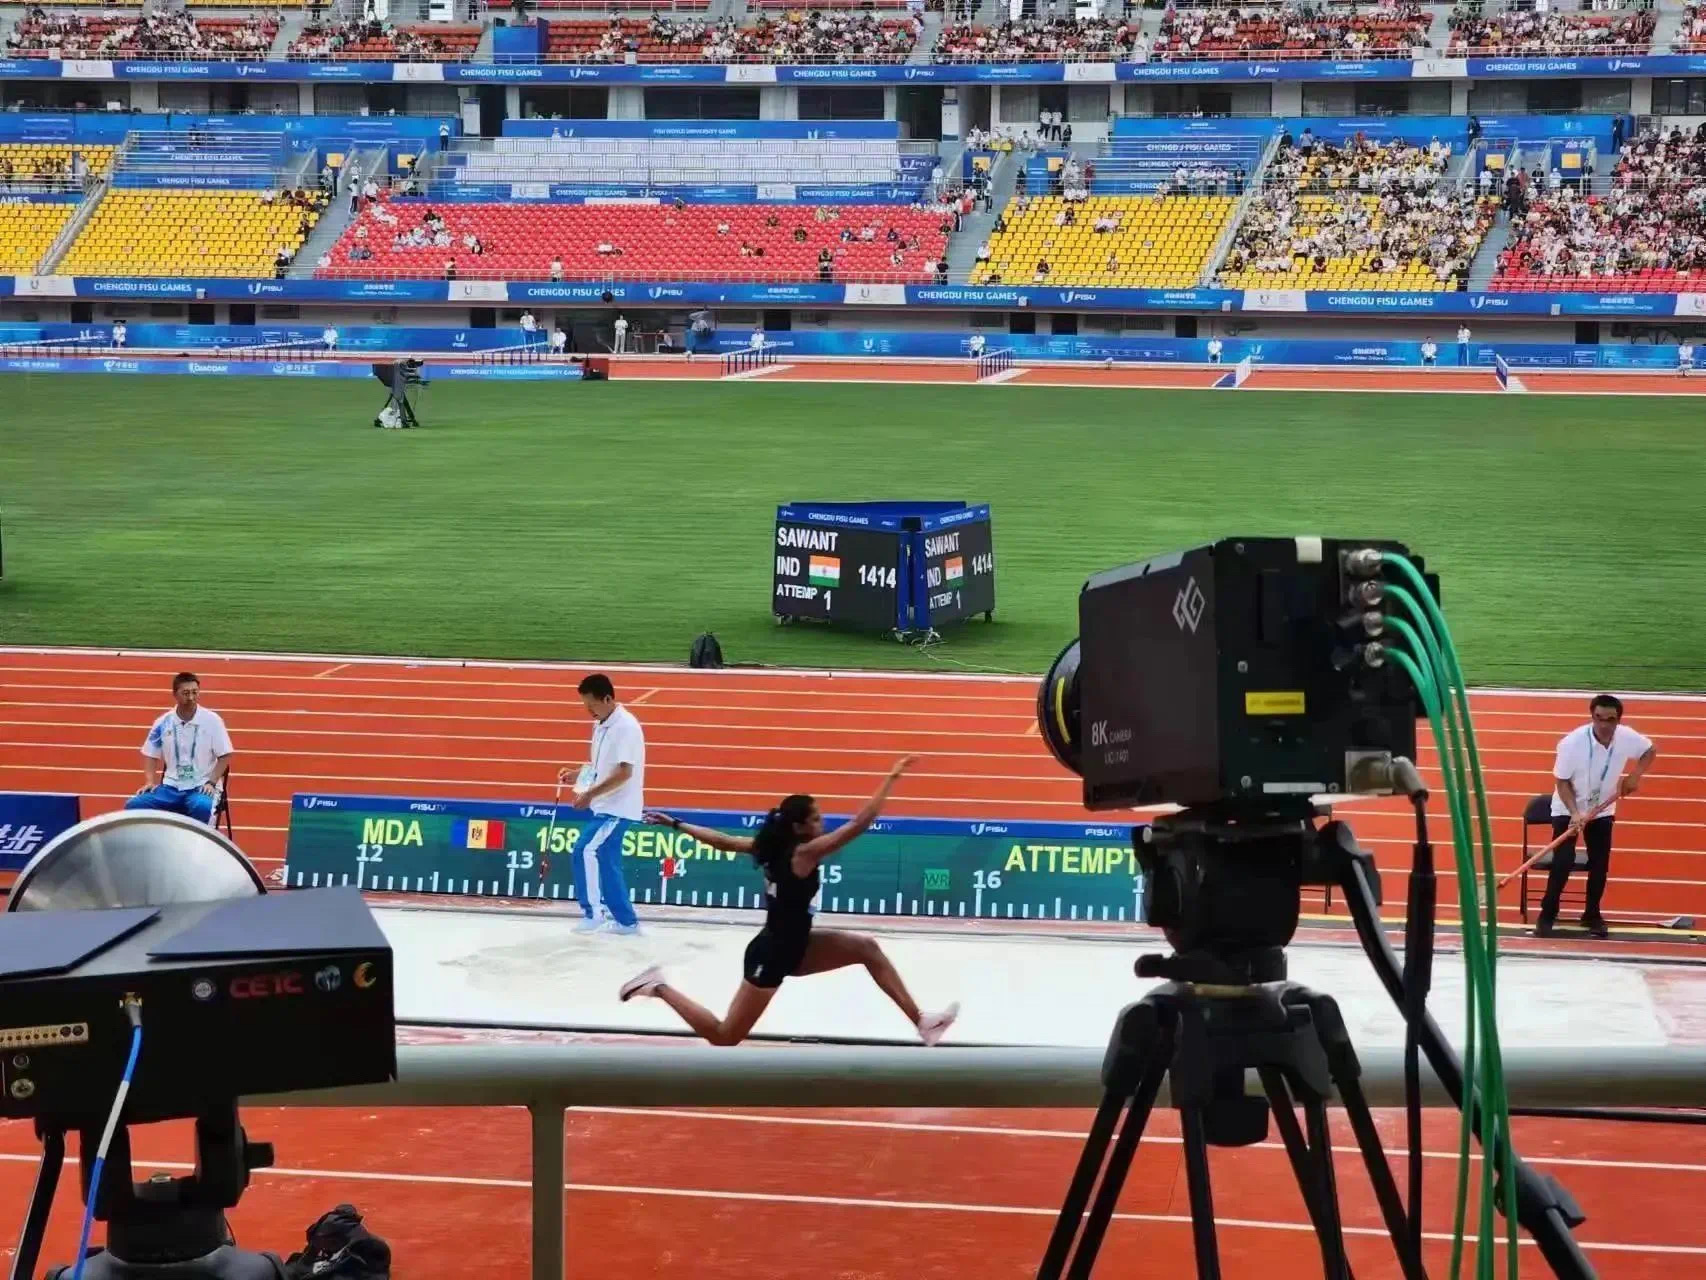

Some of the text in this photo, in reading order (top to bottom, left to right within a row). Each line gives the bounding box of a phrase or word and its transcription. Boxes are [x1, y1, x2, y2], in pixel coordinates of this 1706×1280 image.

[460, 69, 497, 77] CHENGDU
[515, 69, 542, 77] GAMES
[793, 70, 877, 78] CHENGDU FISU GAMES
[1486, 62, 1577, 71] CHENGDU FISU GAMES
[94, 283, 192, 292] CHENGDU FISU GAMES
[528, 288, 571, 297] CHENGDU
[572, 288, 592, 297] FISU
[917, 291, 1018, 300] CHENGDU FISU GAMES
[1328, 296, 1433, 306] CHENGDU FISU GAMES
[808, 512, 835, 522] CHENGDU
[849, 516, 869, 525] GAMES
[777, 527, 838, 552] SAWANT
[924, 532, 960, 558] SAWANT
[776, 555, 801, 577] IND
[971, 552, 993, 576] 1414
[858, 564, 897, 589] 1414
[926, 566, 942, 588] IND
[776, 583, 832, 611] ATTEMP 1
[929, 589, 961, 610] ATTEMP 1
[1091, 720, 1108, 746] 8K
[534, 808, 556, 816] FISU
[362, 818, 423, 847] MDA
[985, 825, 1008, 833] FISU
[536, 826, 581, 854] 158
[356, 843, 383, 862] 12
[506, 850, 533, 869] 13
[1004, 844, 1139, 875] ATTEMPT
[818, 864, 842, 884] 15
[924, 870, 950, 889] WR
[973, 870, 1002, 889] 16
